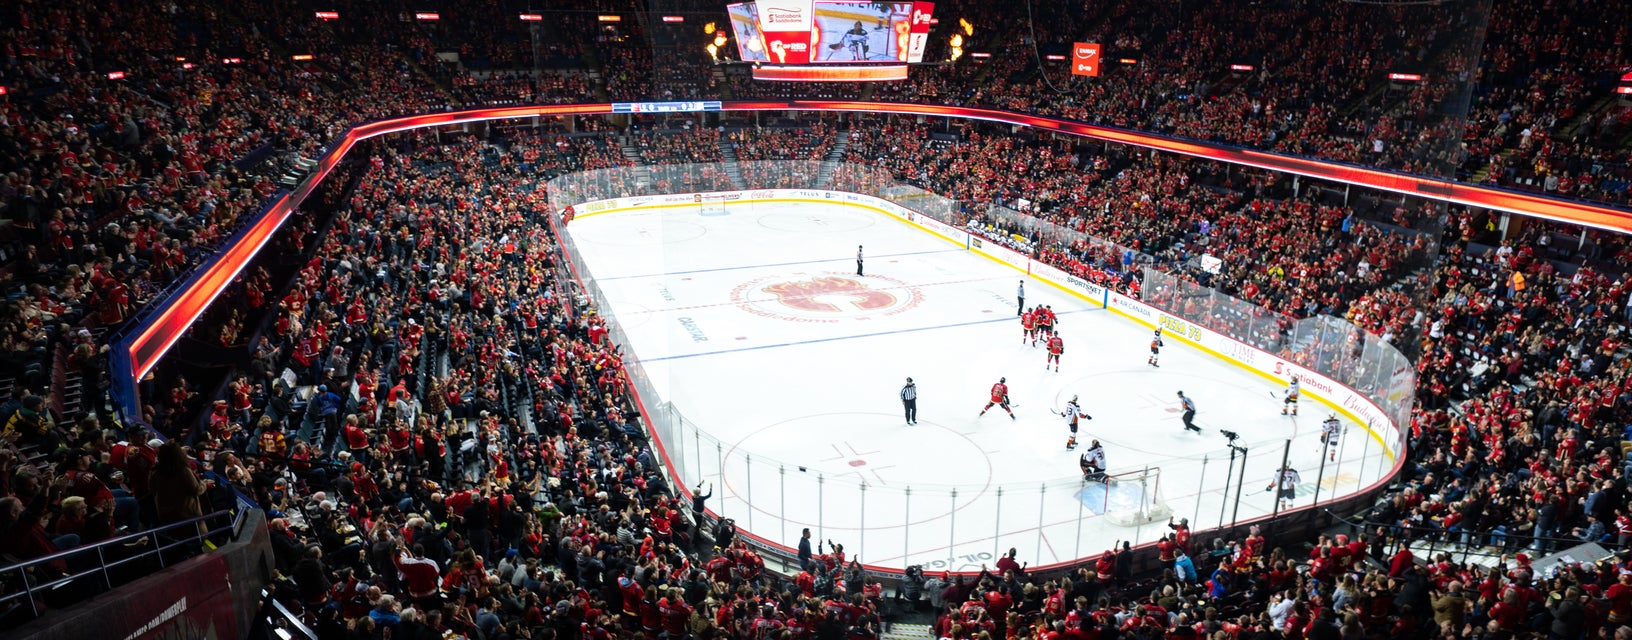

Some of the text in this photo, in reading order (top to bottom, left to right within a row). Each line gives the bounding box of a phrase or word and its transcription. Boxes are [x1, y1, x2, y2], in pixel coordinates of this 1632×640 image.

[1066, 277, 1102, 294] SPORTSNET
[1128, 303, 1151, 317] CANADA
[1159, 313, 1201, 341] PIZZA 73
[1232, 342, 1257, 360] TIME
[1286, 368, 1333, 395] Sotiabank
[1343, 394, 1386, 432] Budweiser
[958, 552, 993, 562] OIL
